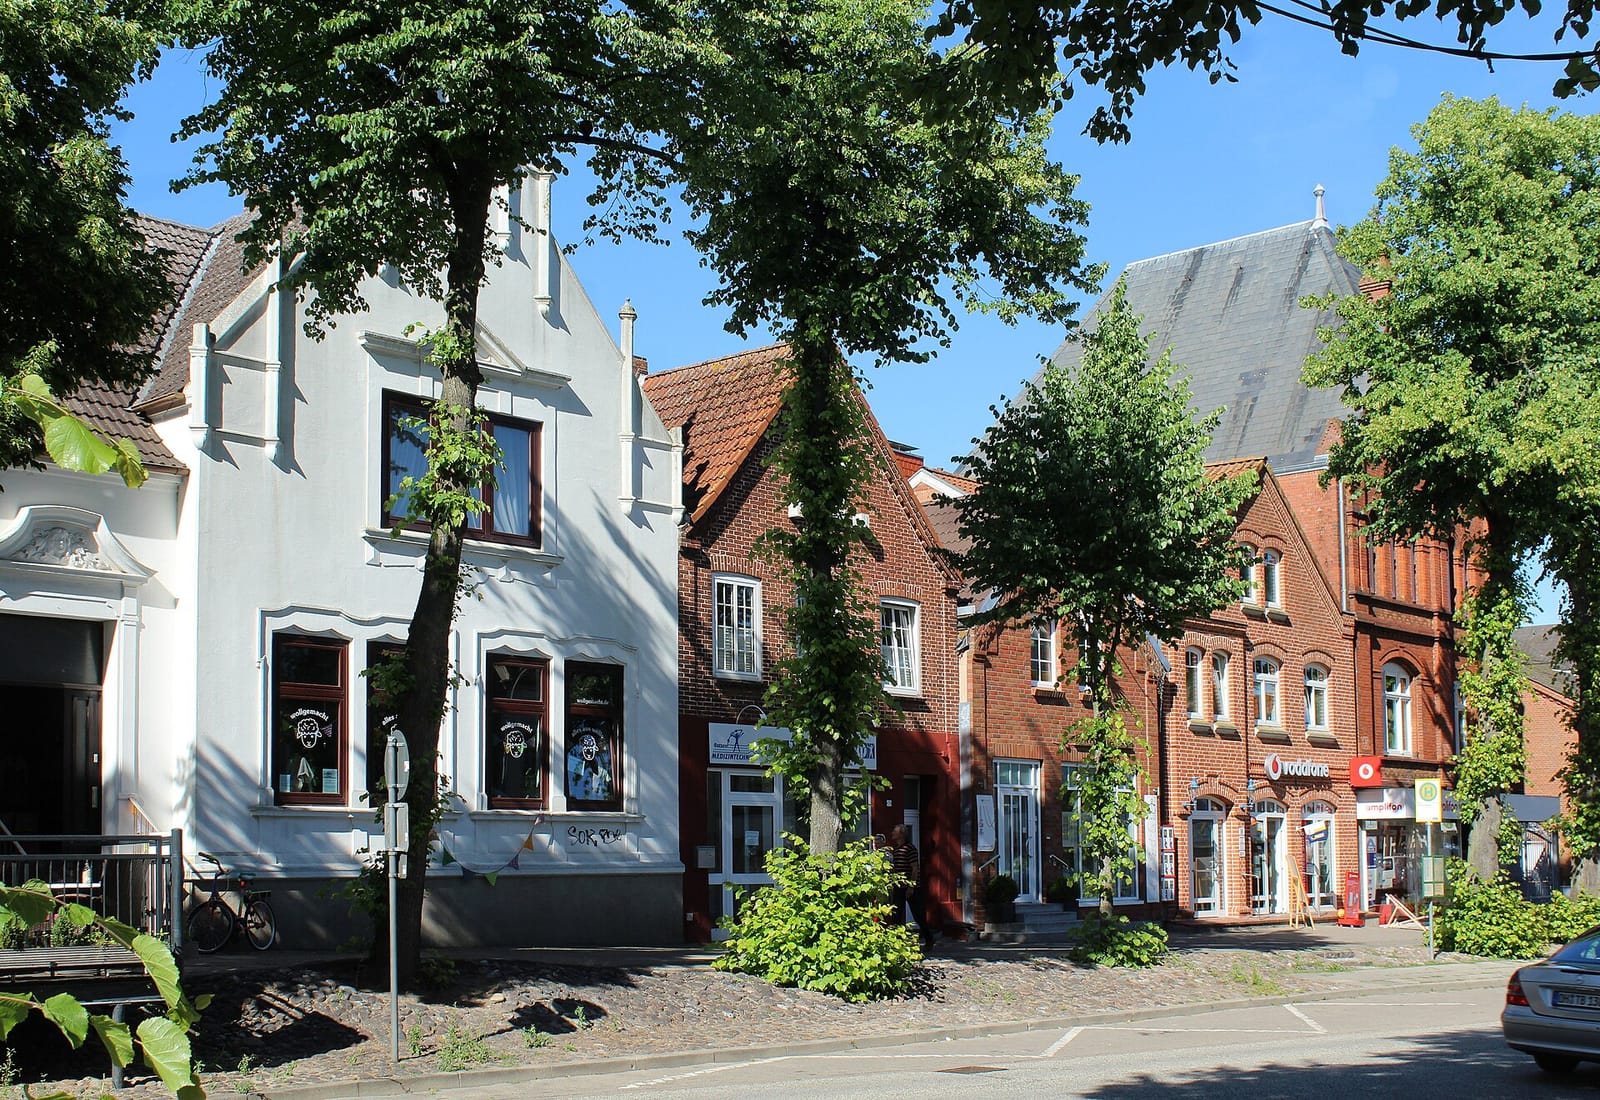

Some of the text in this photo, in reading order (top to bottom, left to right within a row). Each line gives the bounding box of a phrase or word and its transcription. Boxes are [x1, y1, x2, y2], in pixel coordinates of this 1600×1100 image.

[290, 707, 330, 722] wollgemacht
[500, 721, 533, 734] wollgemacht
[1281, 759, 1329, 778] vodafone
[1366, 802, 1403, 812] amplifon
